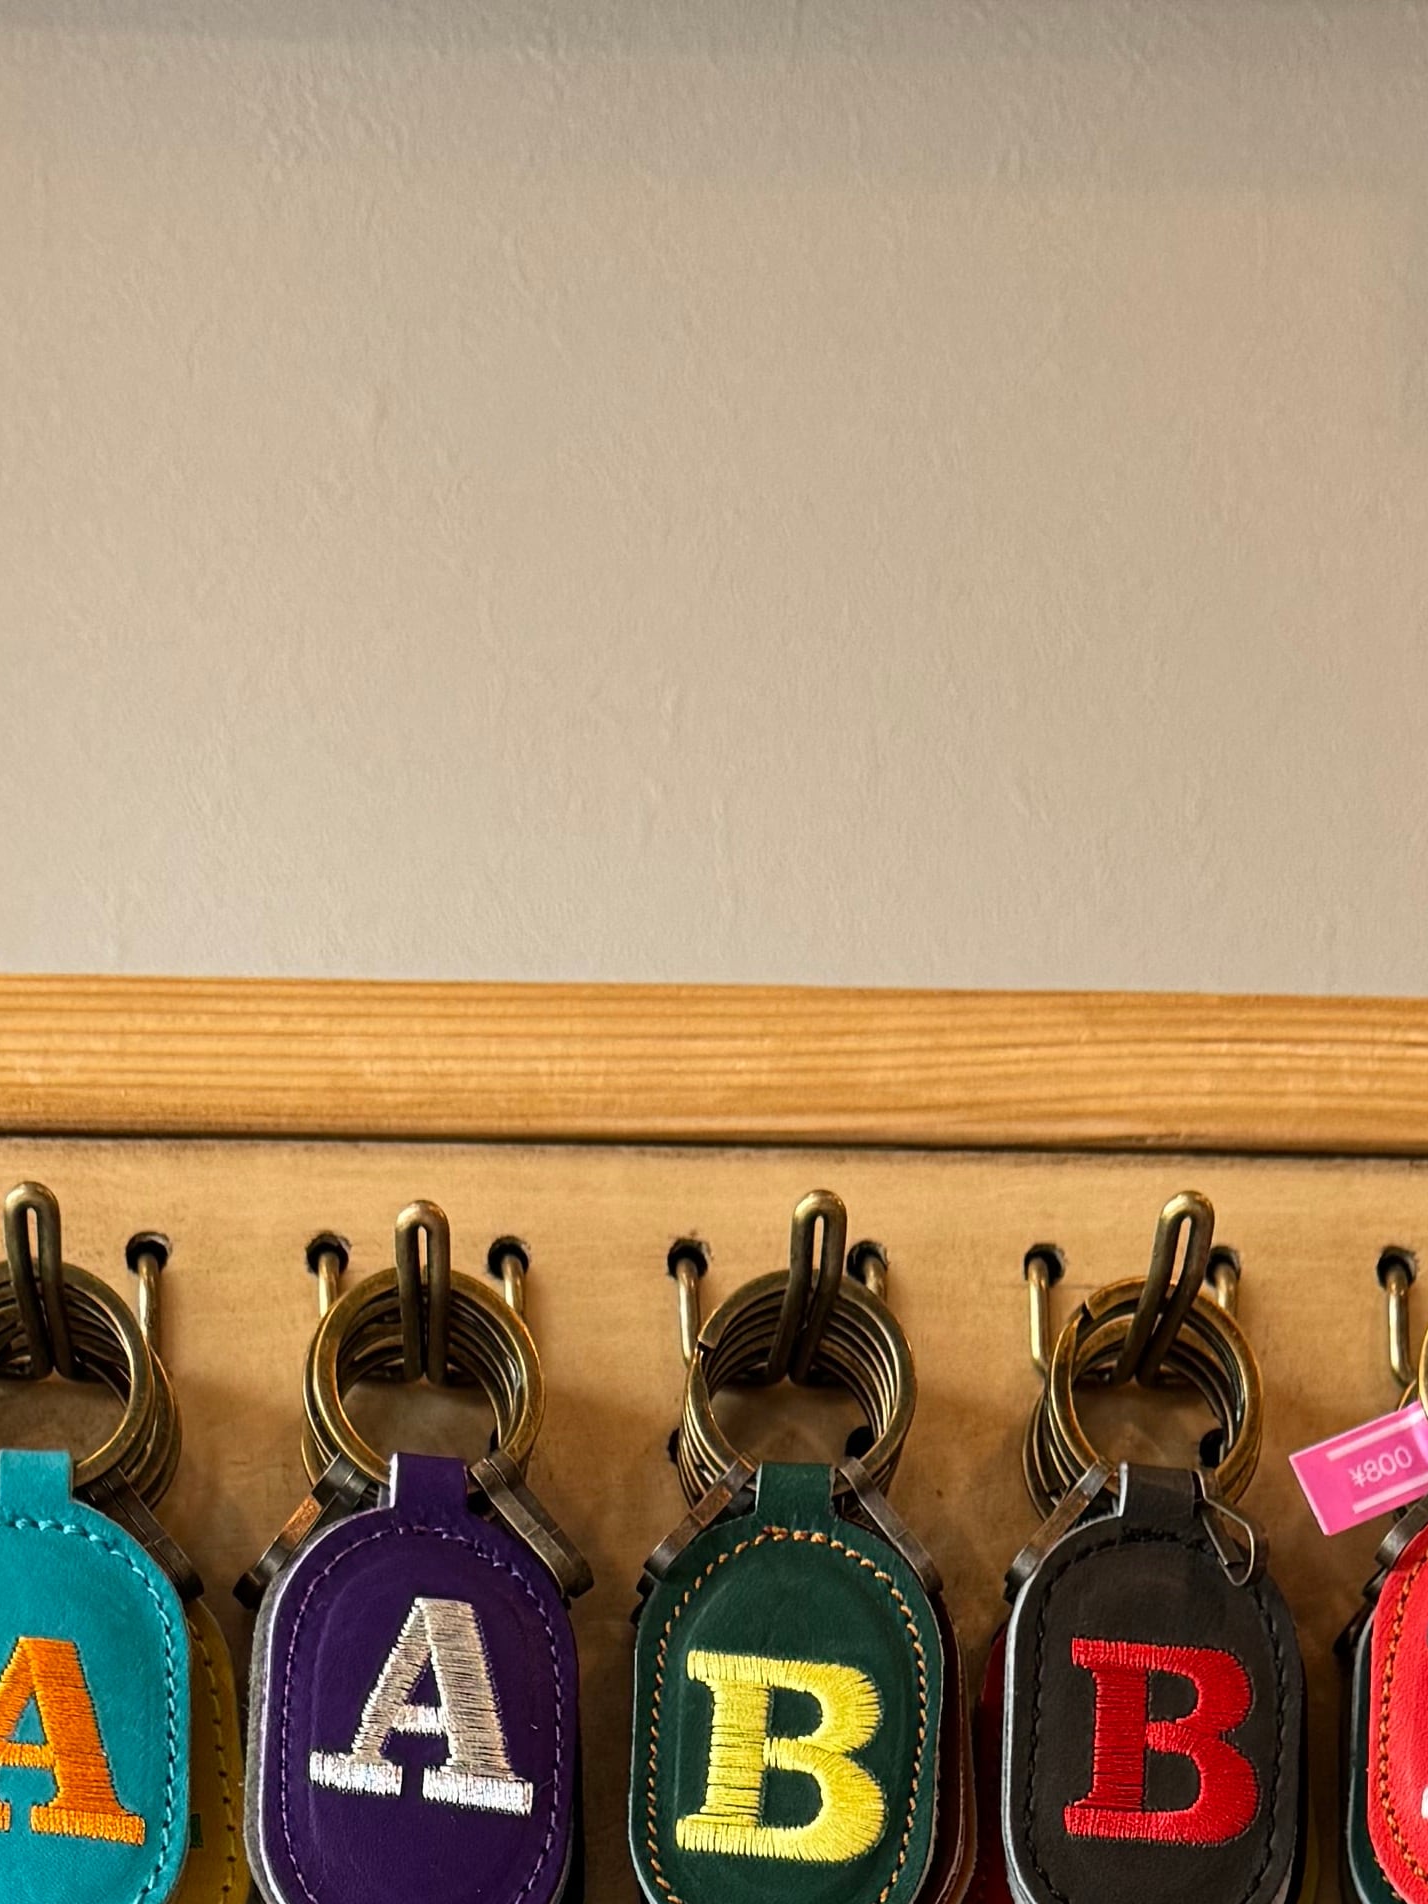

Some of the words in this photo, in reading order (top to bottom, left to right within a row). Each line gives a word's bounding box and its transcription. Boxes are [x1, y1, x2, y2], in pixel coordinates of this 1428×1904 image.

[1348, 1446, 1412, 1487] ¥800
[307, 1596, 535, 1818] A
[674, 1648, 887, 1863] B
[1063, 1636, 1263, 1848] B
